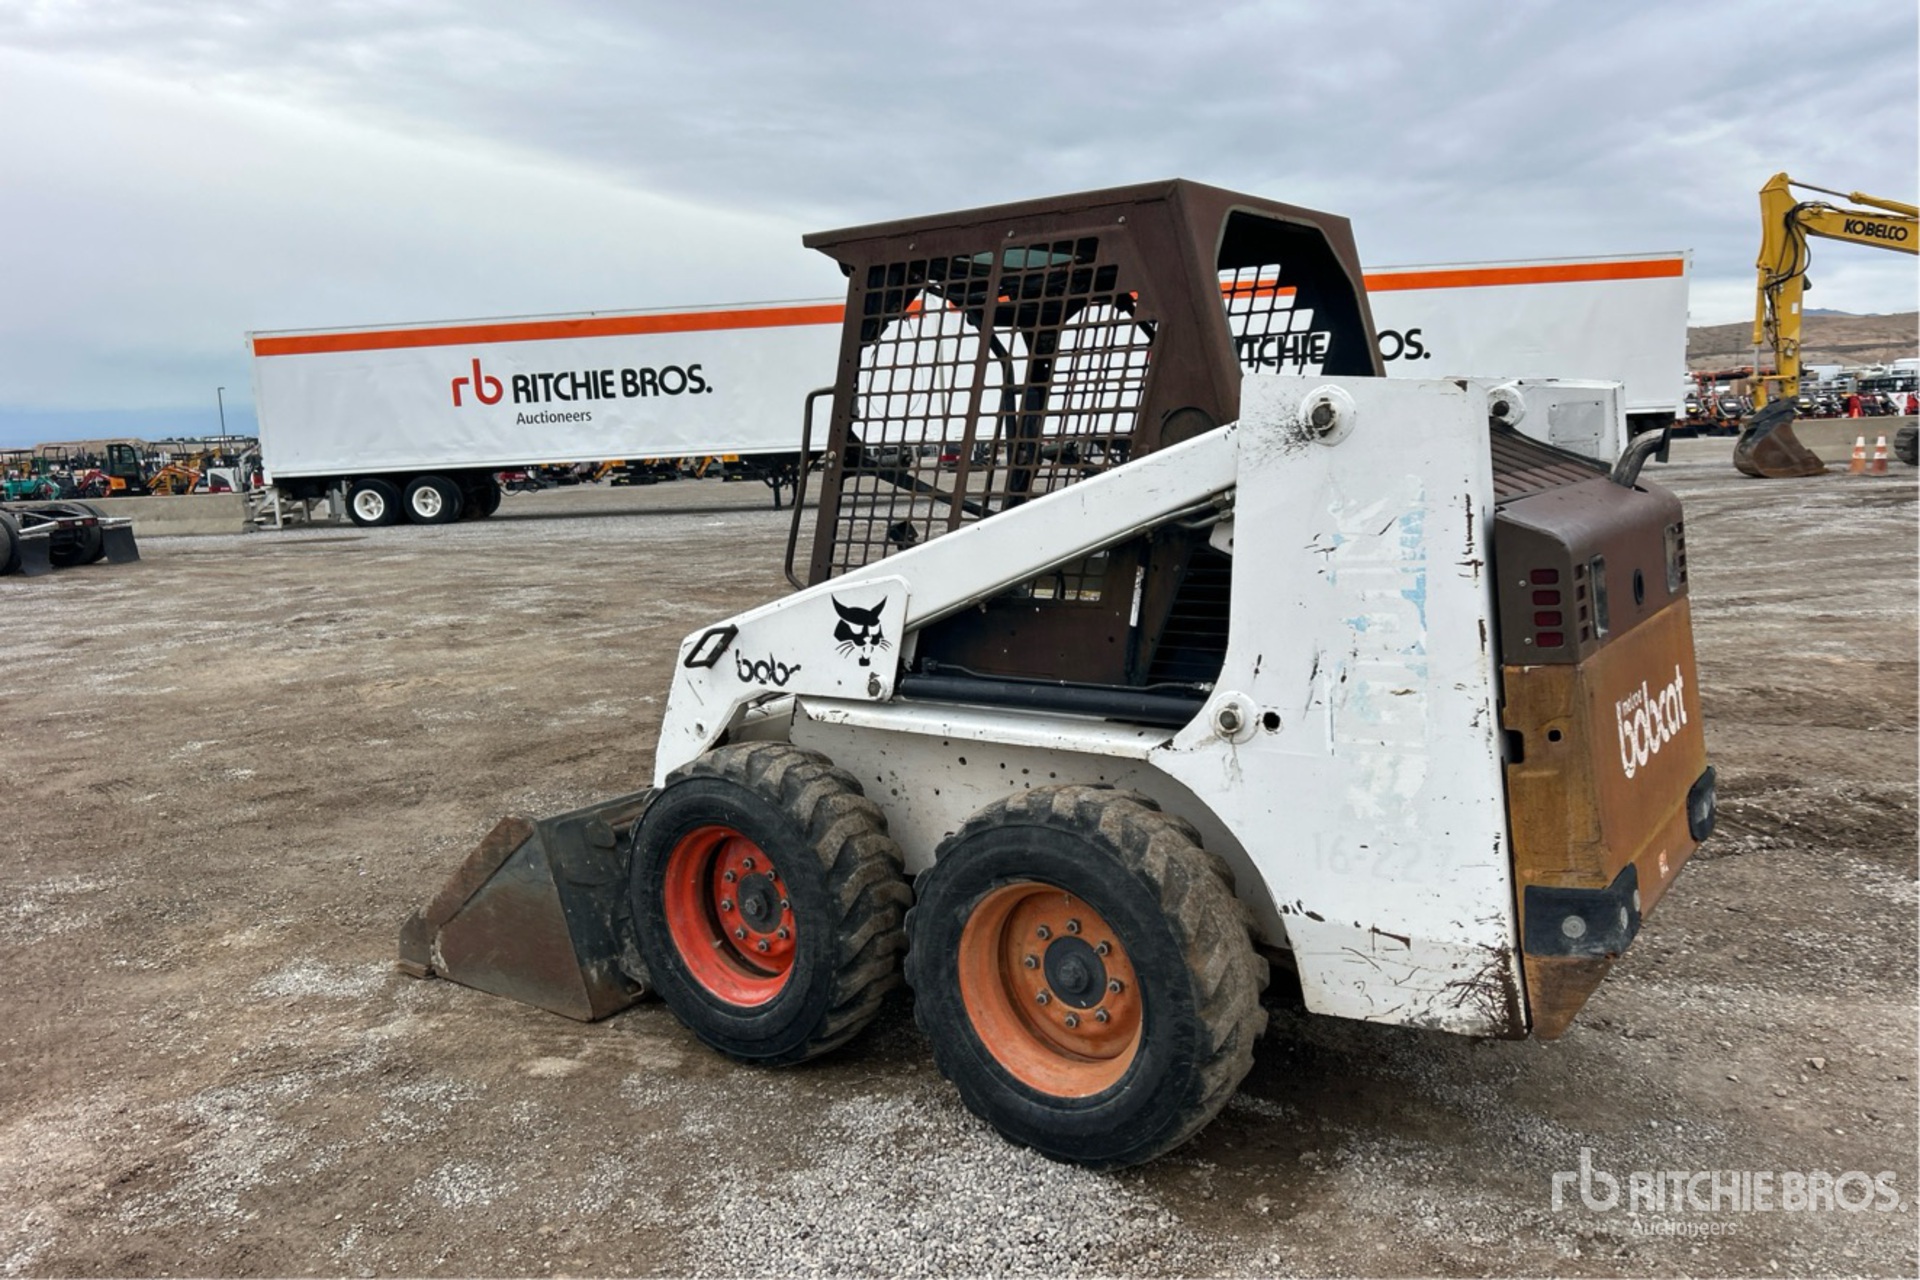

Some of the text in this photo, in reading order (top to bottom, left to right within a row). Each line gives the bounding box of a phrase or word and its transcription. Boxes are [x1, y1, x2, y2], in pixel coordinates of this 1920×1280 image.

[1843, 218, 1908, 241] KOBELCO
[1234, 328, 1431, 368] ITCHIE OS.
[451, 358, 504, 407] rb
[512, 363, 713, 404] RITCHIE BROS.
[516, 410, 592, 425] Auctioneers
[1615, 664, 1687, 779] bobcat
